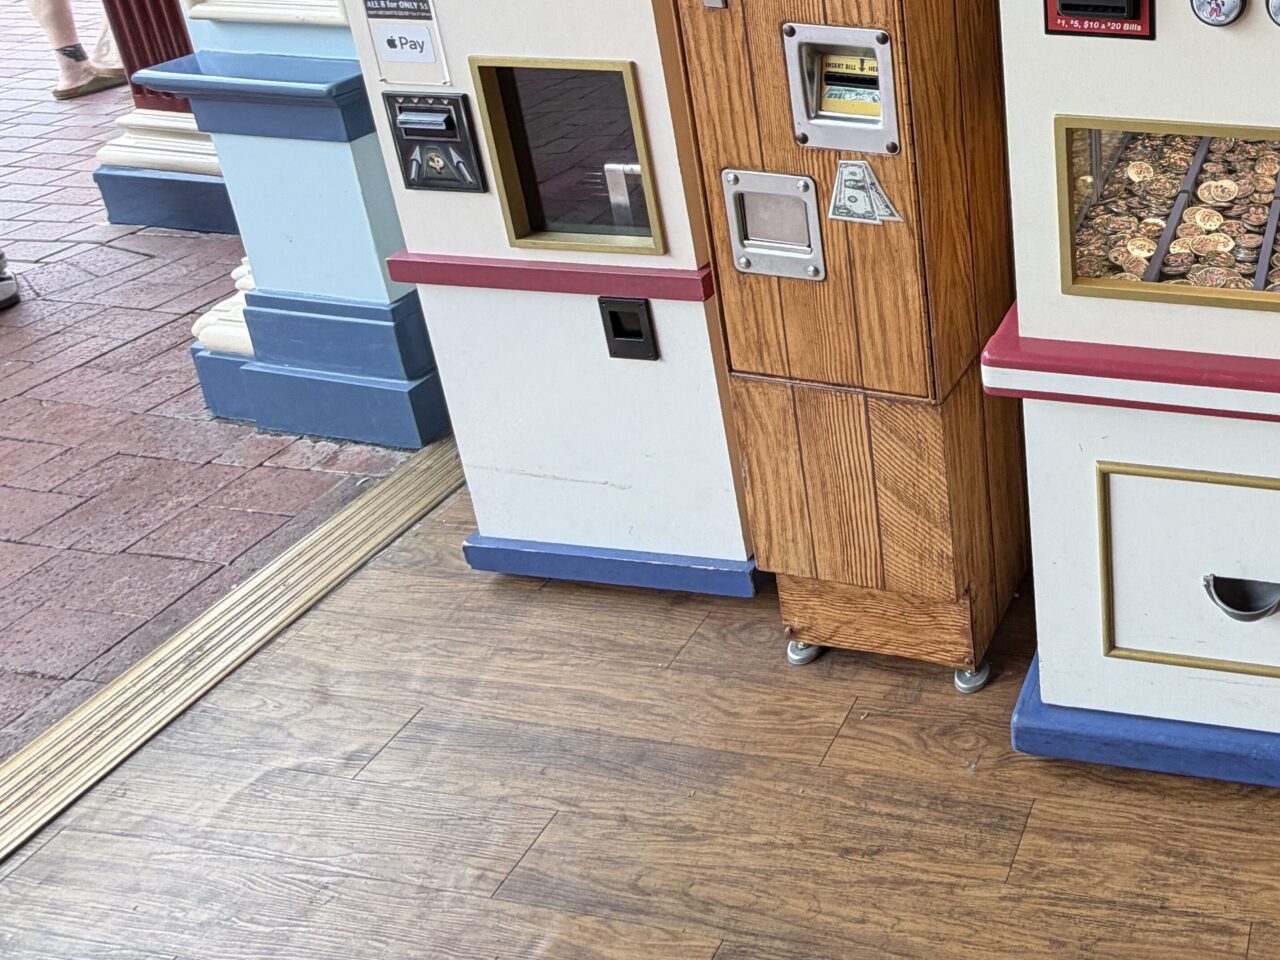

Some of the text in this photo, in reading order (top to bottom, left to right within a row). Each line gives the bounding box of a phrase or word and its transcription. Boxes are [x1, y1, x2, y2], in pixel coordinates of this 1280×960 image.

[367, 0, 380, 8] ALL
[387, 0, 398, 8] for
[399, 1, 418, 9] ONLY
[1083, 20, 1100, 29] $10
[1107, 21, 1122, 30] $20
[1122, 23, 1142, 31] Bills
[399, 36, 425, 54] Pay
